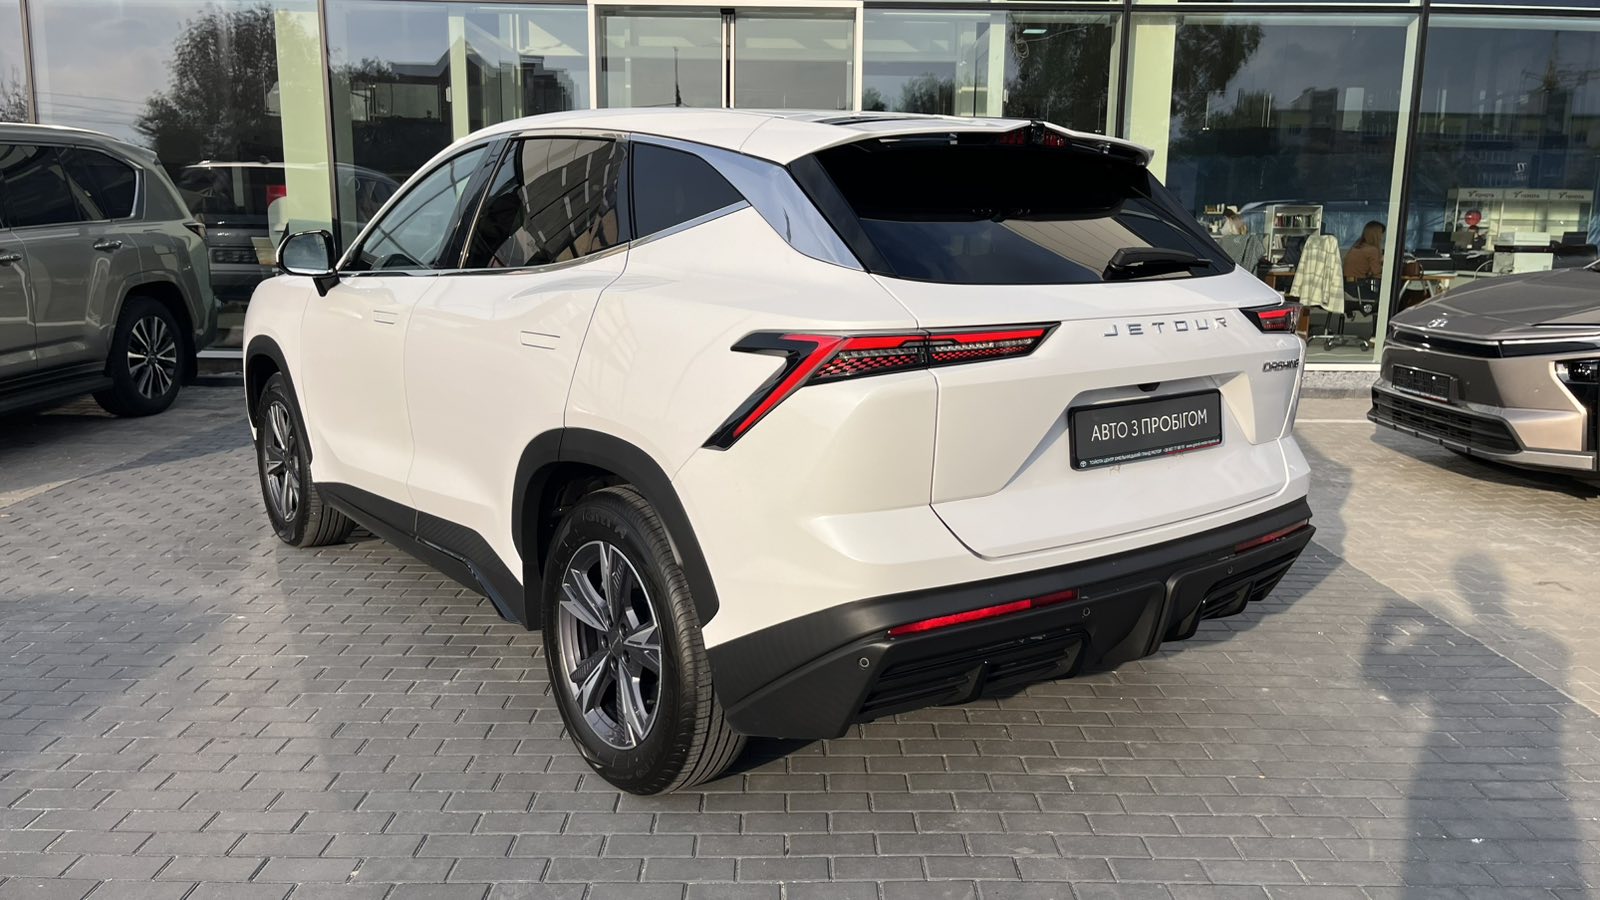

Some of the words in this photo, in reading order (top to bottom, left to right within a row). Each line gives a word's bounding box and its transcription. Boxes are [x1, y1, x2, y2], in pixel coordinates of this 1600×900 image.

[1104, 317, 1228, 337] JETOUR
[1091, 421, 1128, 442] АВТО
[1141, 409, 1208, 435] ПРОБІГОМ
